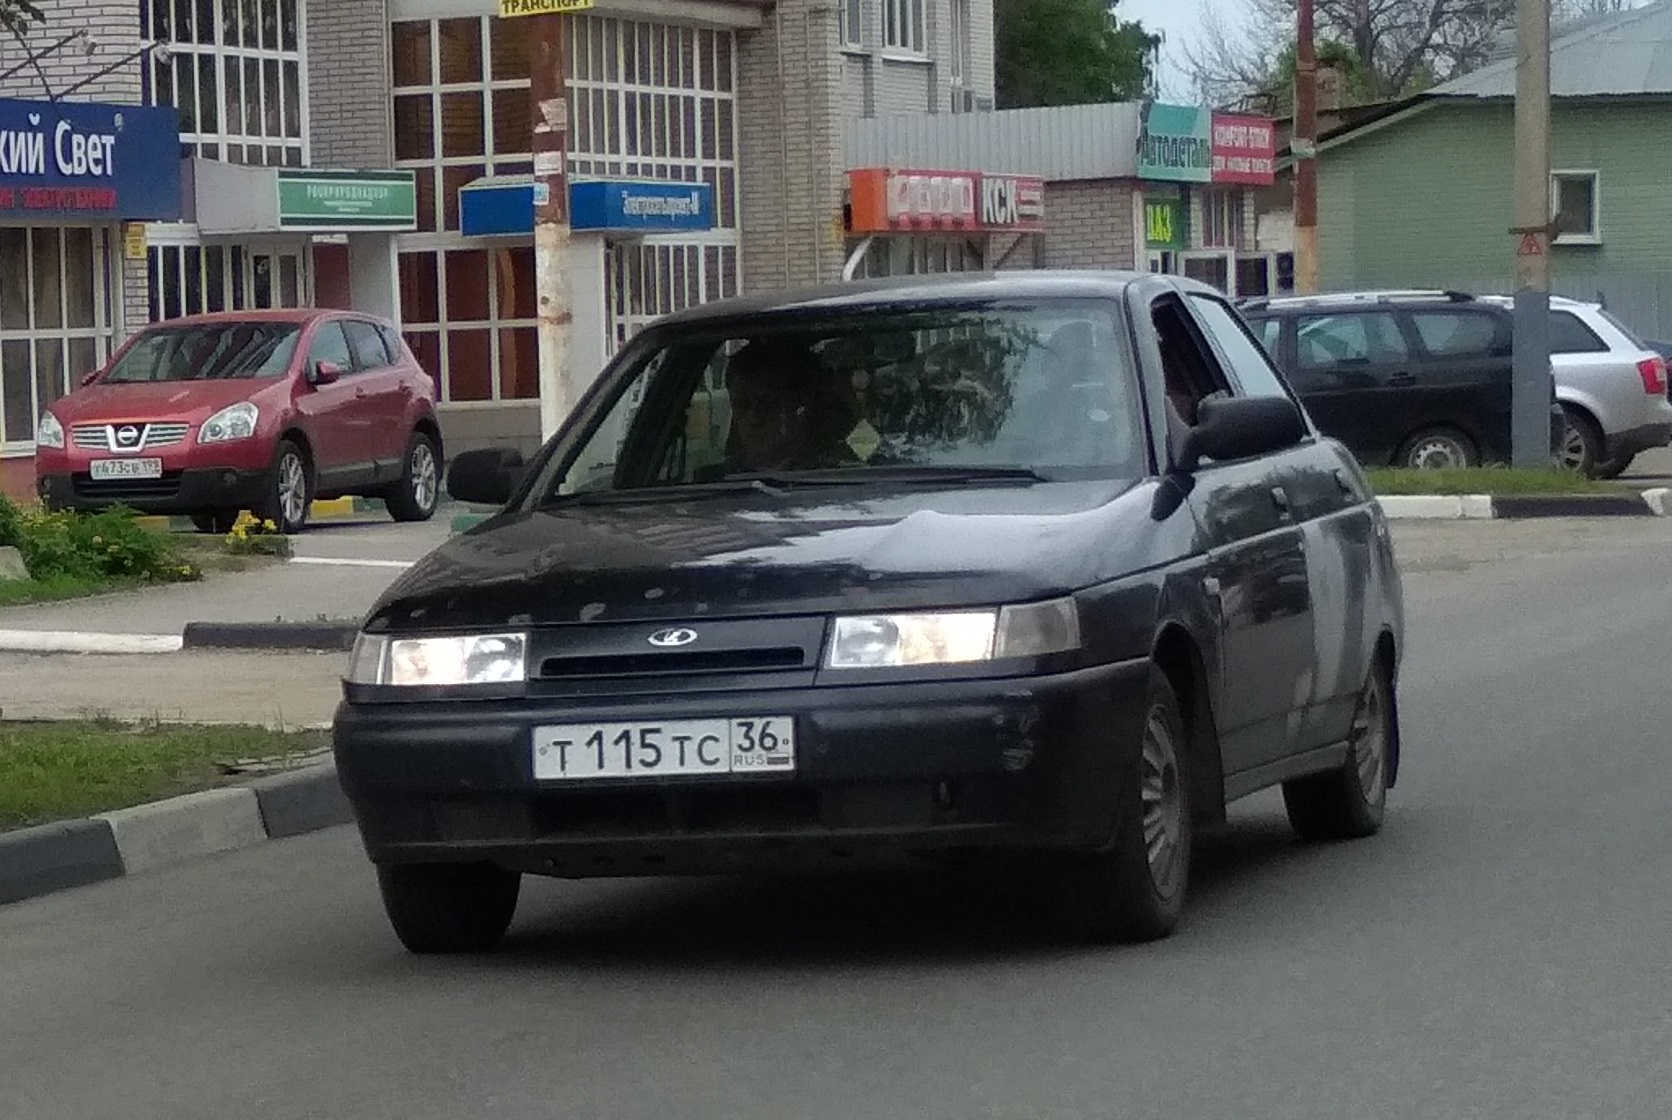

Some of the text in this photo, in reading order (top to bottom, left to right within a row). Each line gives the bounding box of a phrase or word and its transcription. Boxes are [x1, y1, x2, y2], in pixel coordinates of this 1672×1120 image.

[55, 119, 116, 176] Свет
[982, 178, 1018, 223] КСК
[736, 721, 779, 752] 36
[734, 755, 766, 765] RUS
